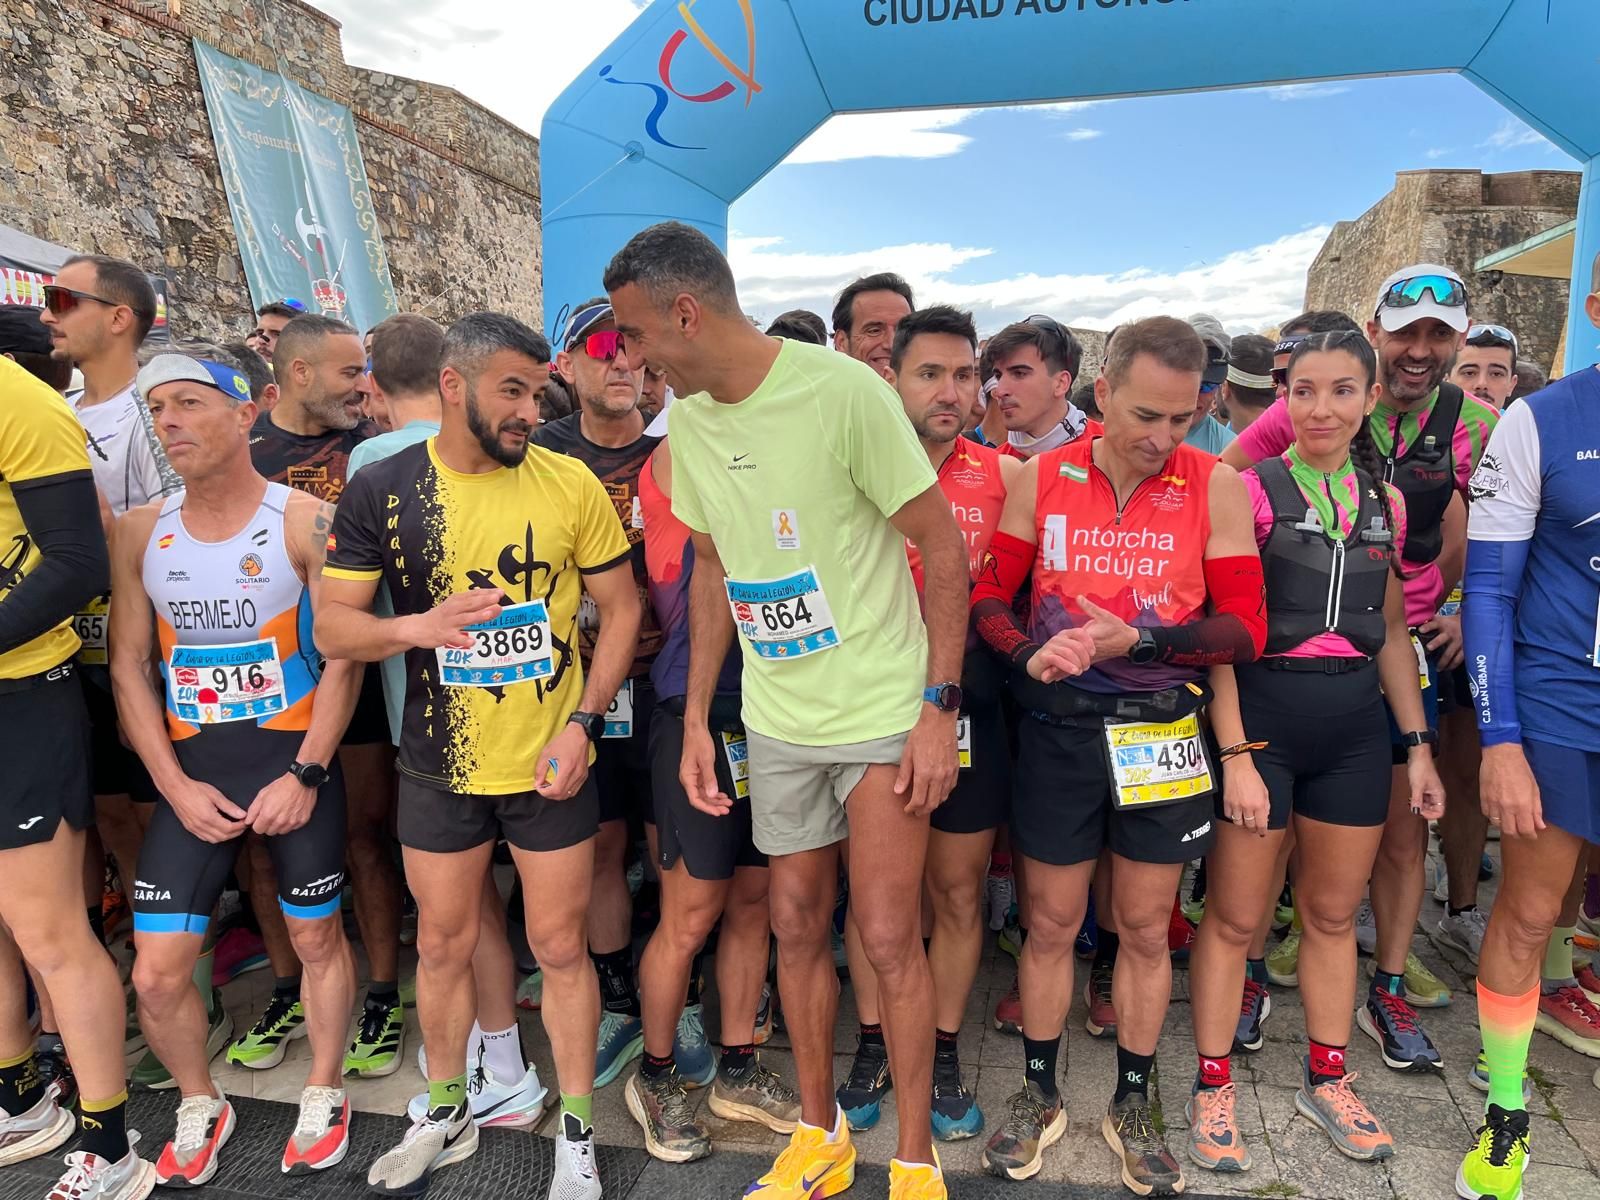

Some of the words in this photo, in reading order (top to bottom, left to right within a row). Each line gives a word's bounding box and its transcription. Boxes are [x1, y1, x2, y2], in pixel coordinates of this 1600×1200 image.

[864, 0, 1003, 26] CIUDAD
[1127, 581, 1172, 610] trail
[168, 598, 256, 630] BERMEJO
[761, 597, 812, 631] 664
[476, 625, 543, 657] 3869
[212, 664, 264, 693] 916
[1476, 654, 1488, 689] URBANO
[1481, 690, 1489, 706] SAN
